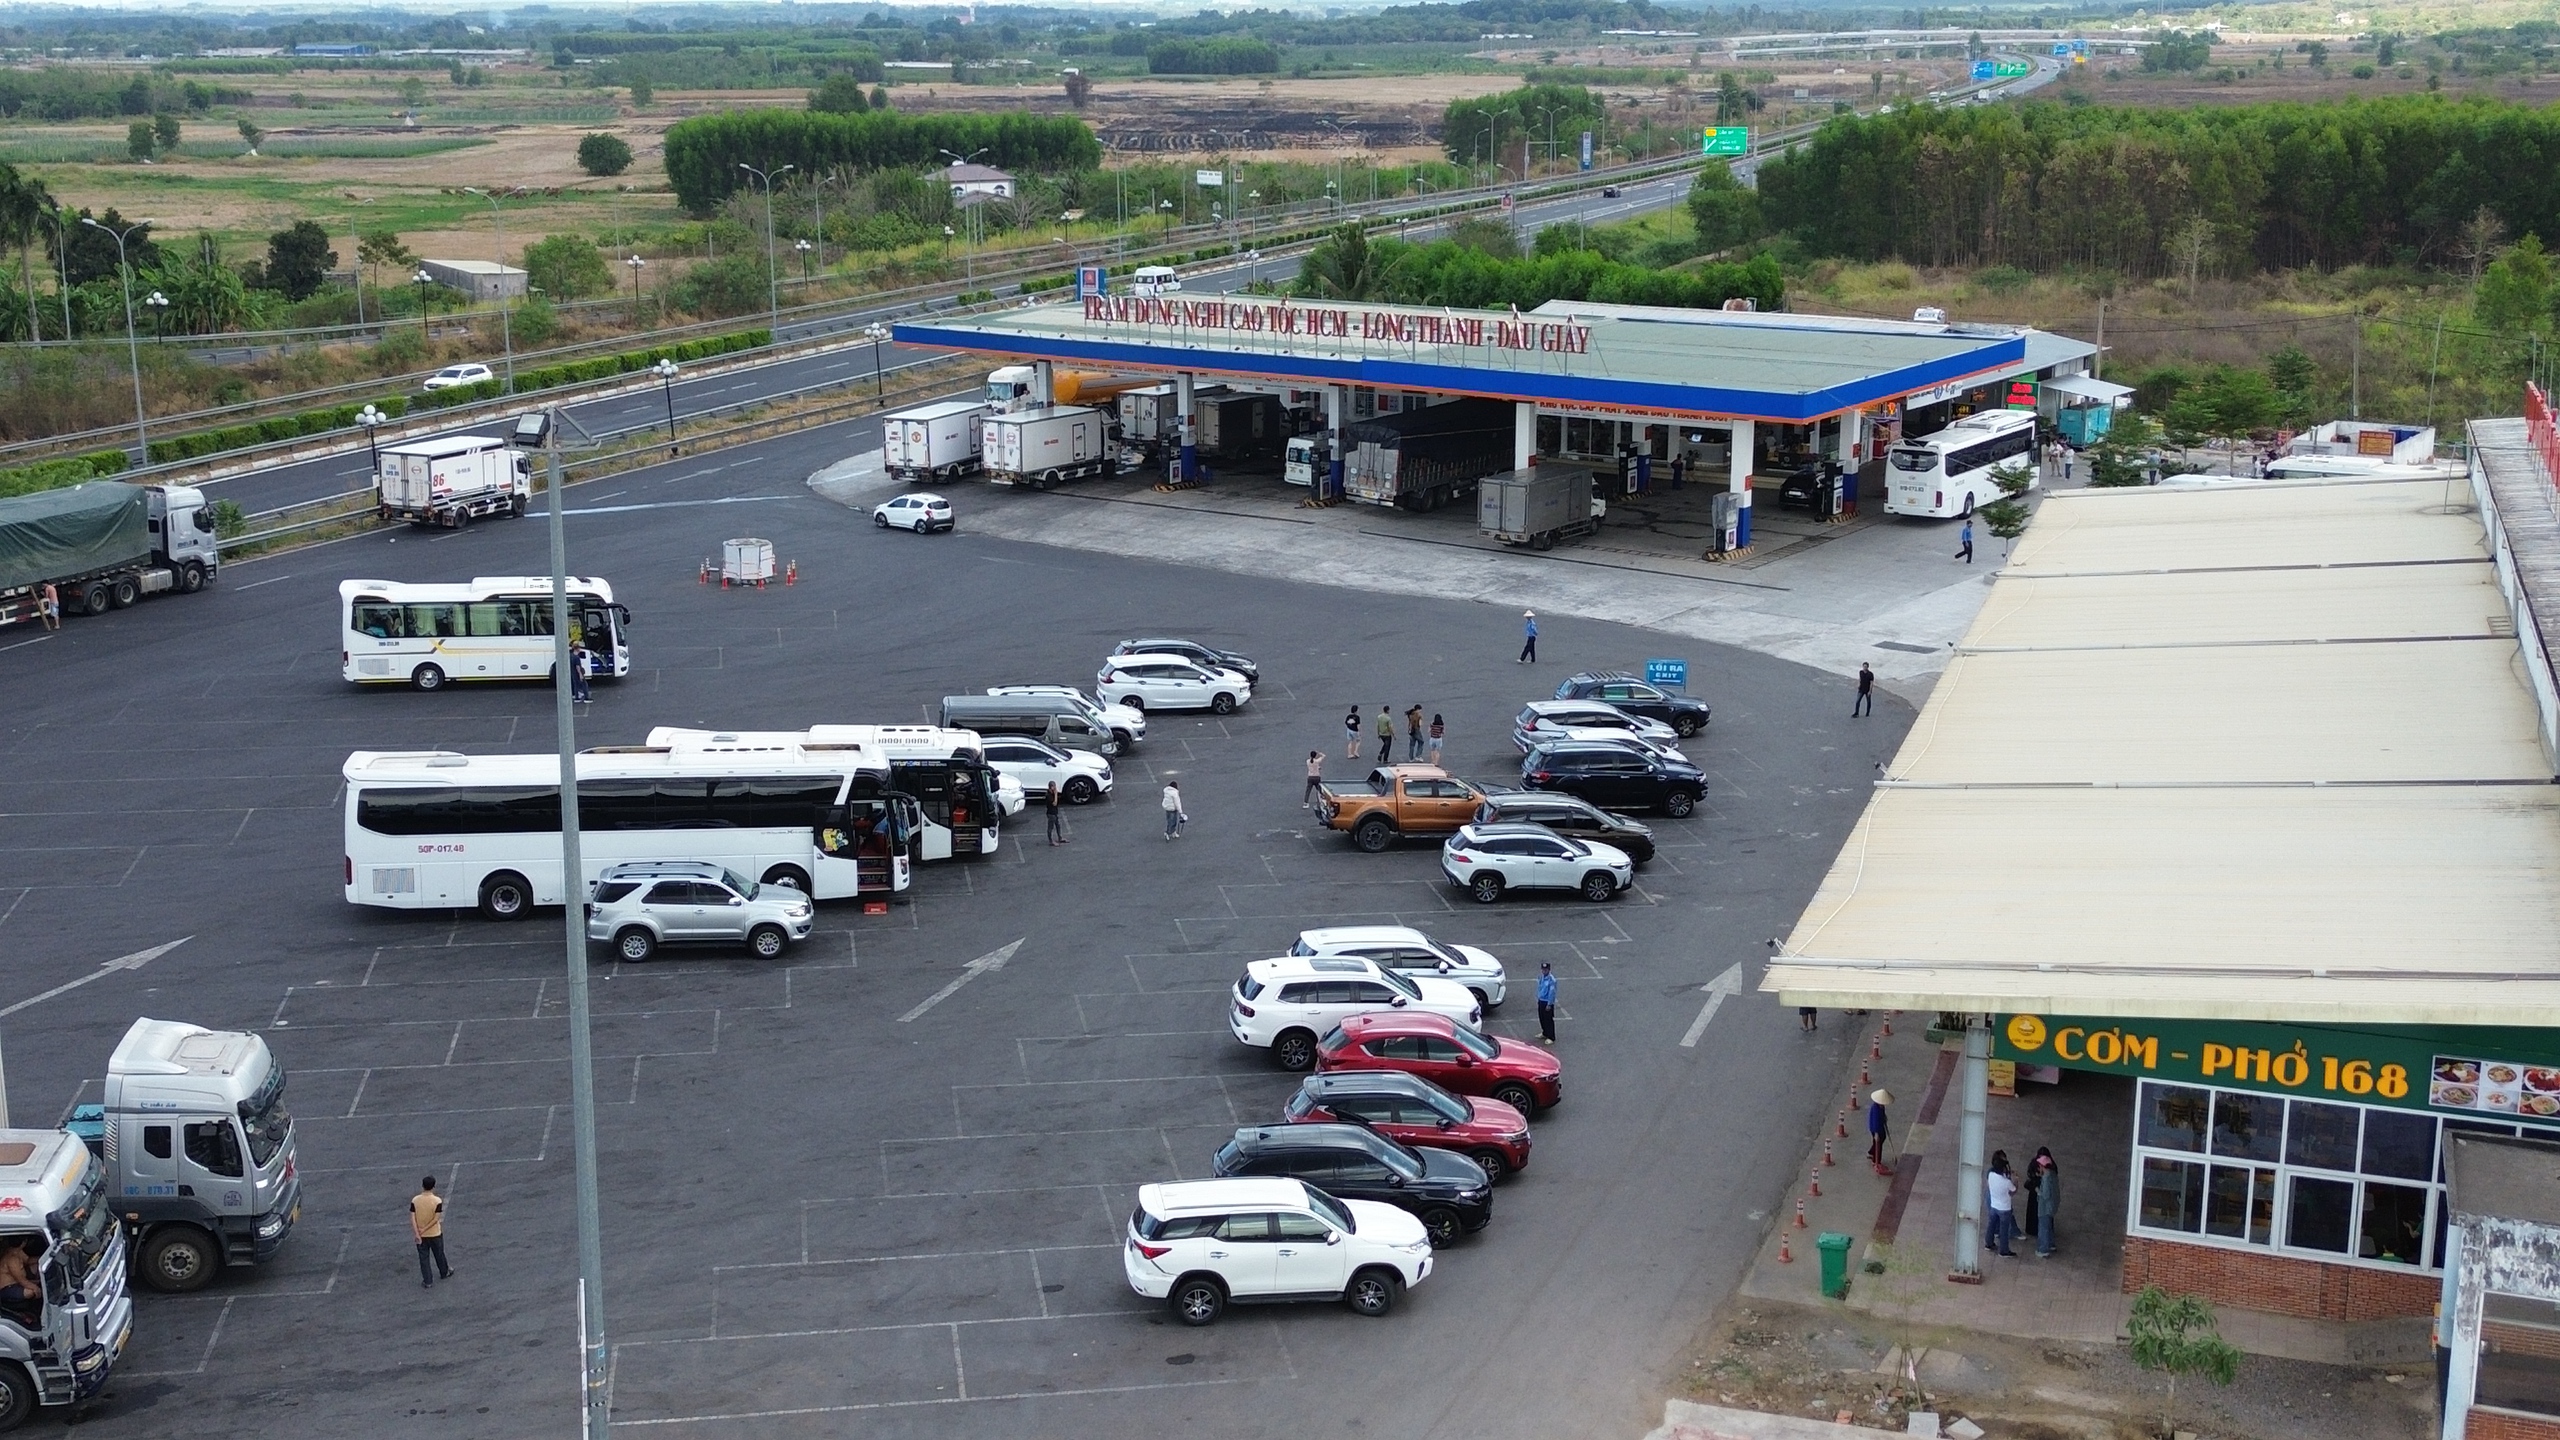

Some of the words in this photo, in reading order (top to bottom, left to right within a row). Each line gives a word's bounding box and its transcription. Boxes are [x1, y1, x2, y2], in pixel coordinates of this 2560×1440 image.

[1230, 303, 1264, 332] CAO
[1306, 308, 1351, 338] HCM
[1363, 311, 1413, 343] LONG
[1416, 305, 1485, 347] THÀNH
[1497, 302, 1536, 352] DẦU
[1540, 313, 1592, 355] GIÂY
[432, 473, 445, 487] 86
[2053, 1026, 2158, 1070] CƠM
[2201, 1038, 2310, 1087] PHỞ
[2321, 1055, 2410, 1099] 168
